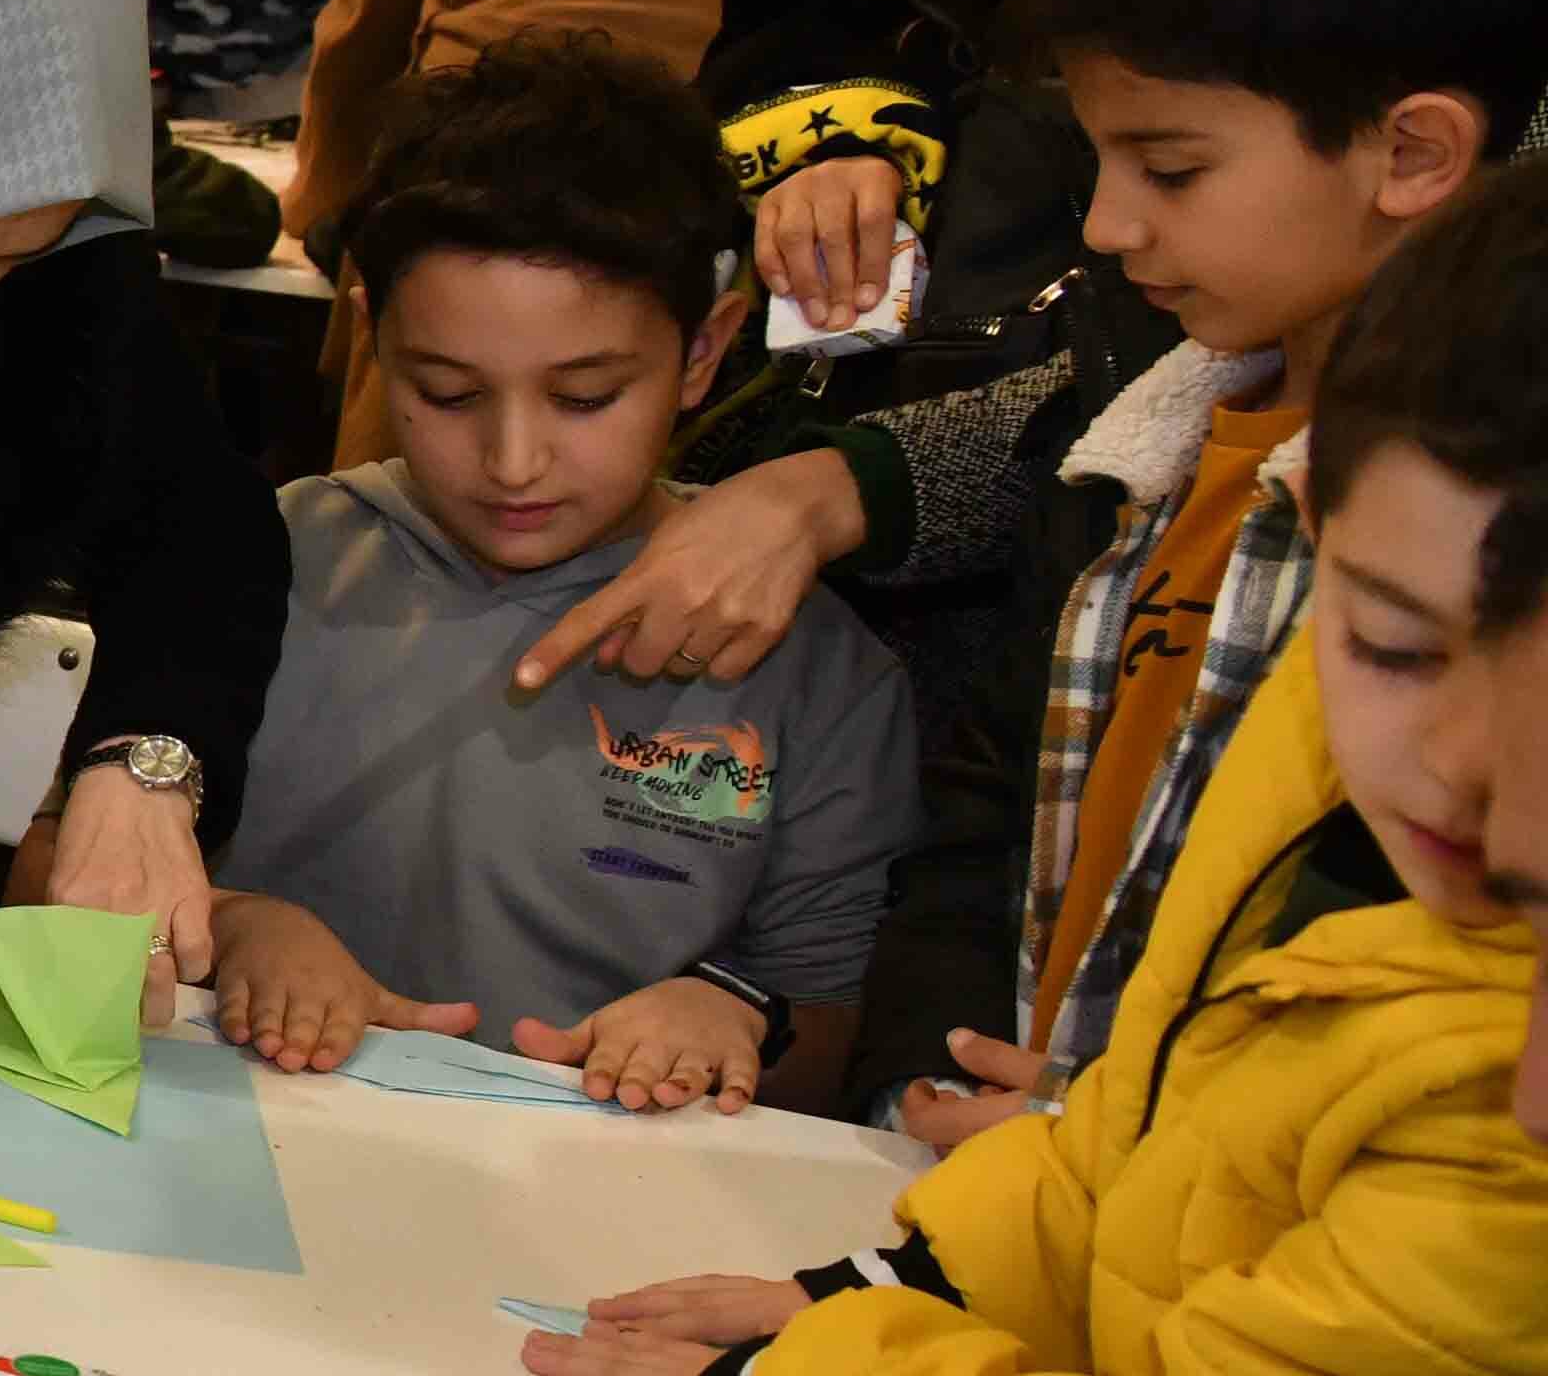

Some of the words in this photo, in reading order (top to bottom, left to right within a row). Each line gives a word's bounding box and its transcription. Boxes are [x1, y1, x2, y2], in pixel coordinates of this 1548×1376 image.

[610, 732, 693, 774] URBAN
[699, 753, 777, 793] STREET
[643, 776, 704, 801] MOVING
